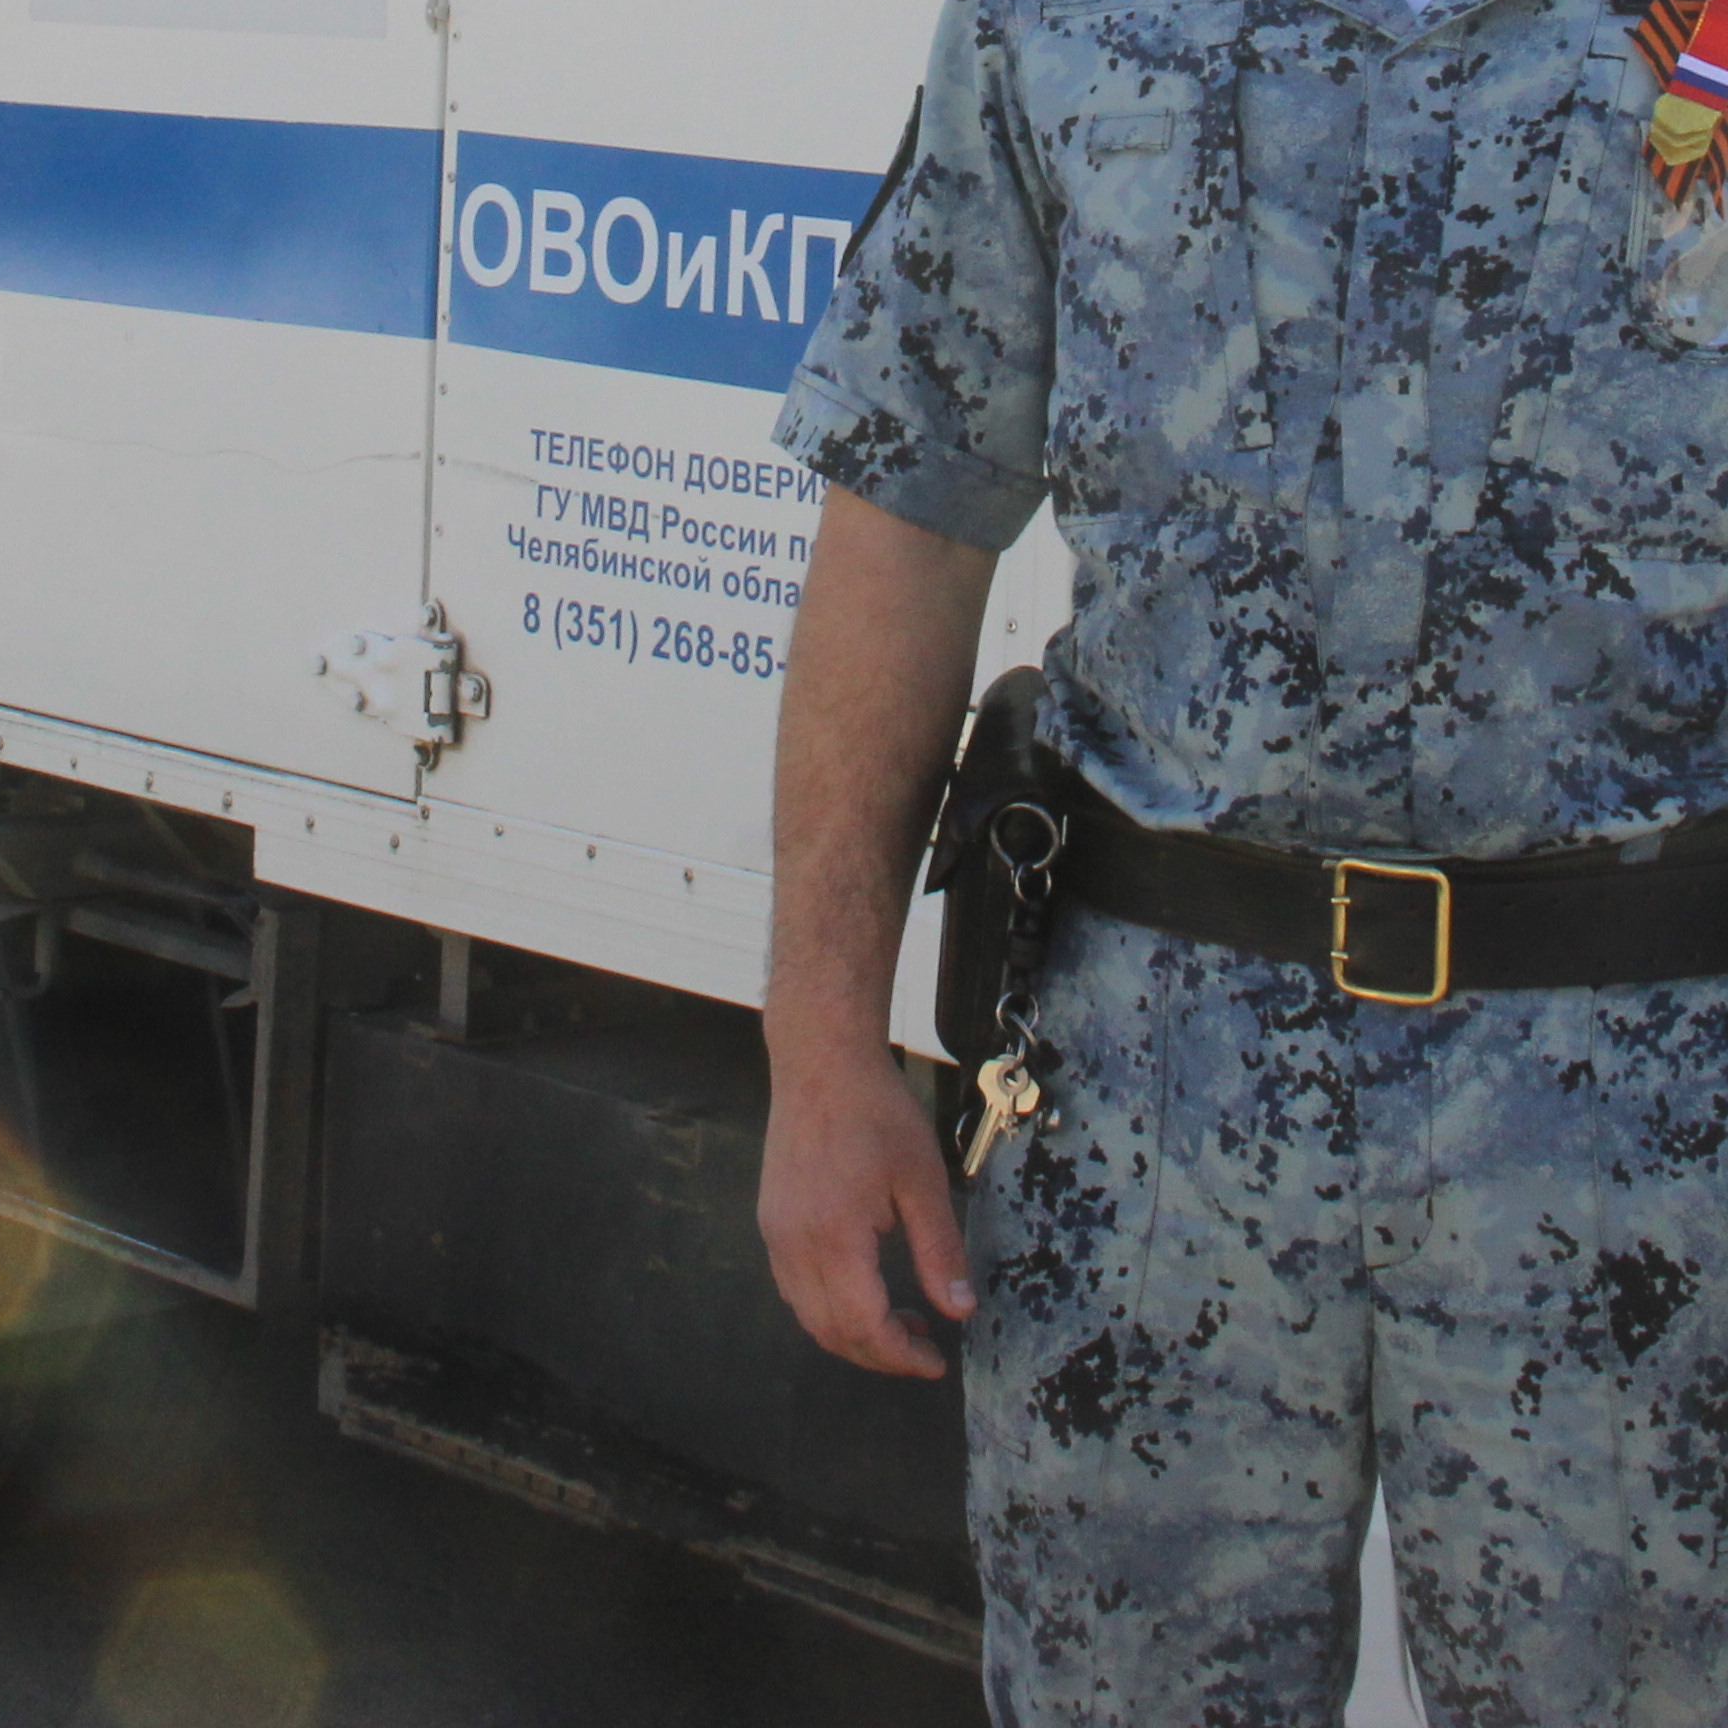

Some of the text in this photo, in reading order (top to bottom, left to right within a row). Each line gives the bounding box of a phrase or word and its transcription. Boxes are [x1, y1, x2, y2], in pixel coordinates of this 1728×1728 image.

[458, 183, 854, 325] ОВОиКП
[530, 429, 675, 483] ТЕЛЕФОН
[507, 523, 801, 609] Челябинской обла
[536, 484, 816, 563] ГУ МВД России п
[523, 593, 788, 680] 8 (351) 268-85-
